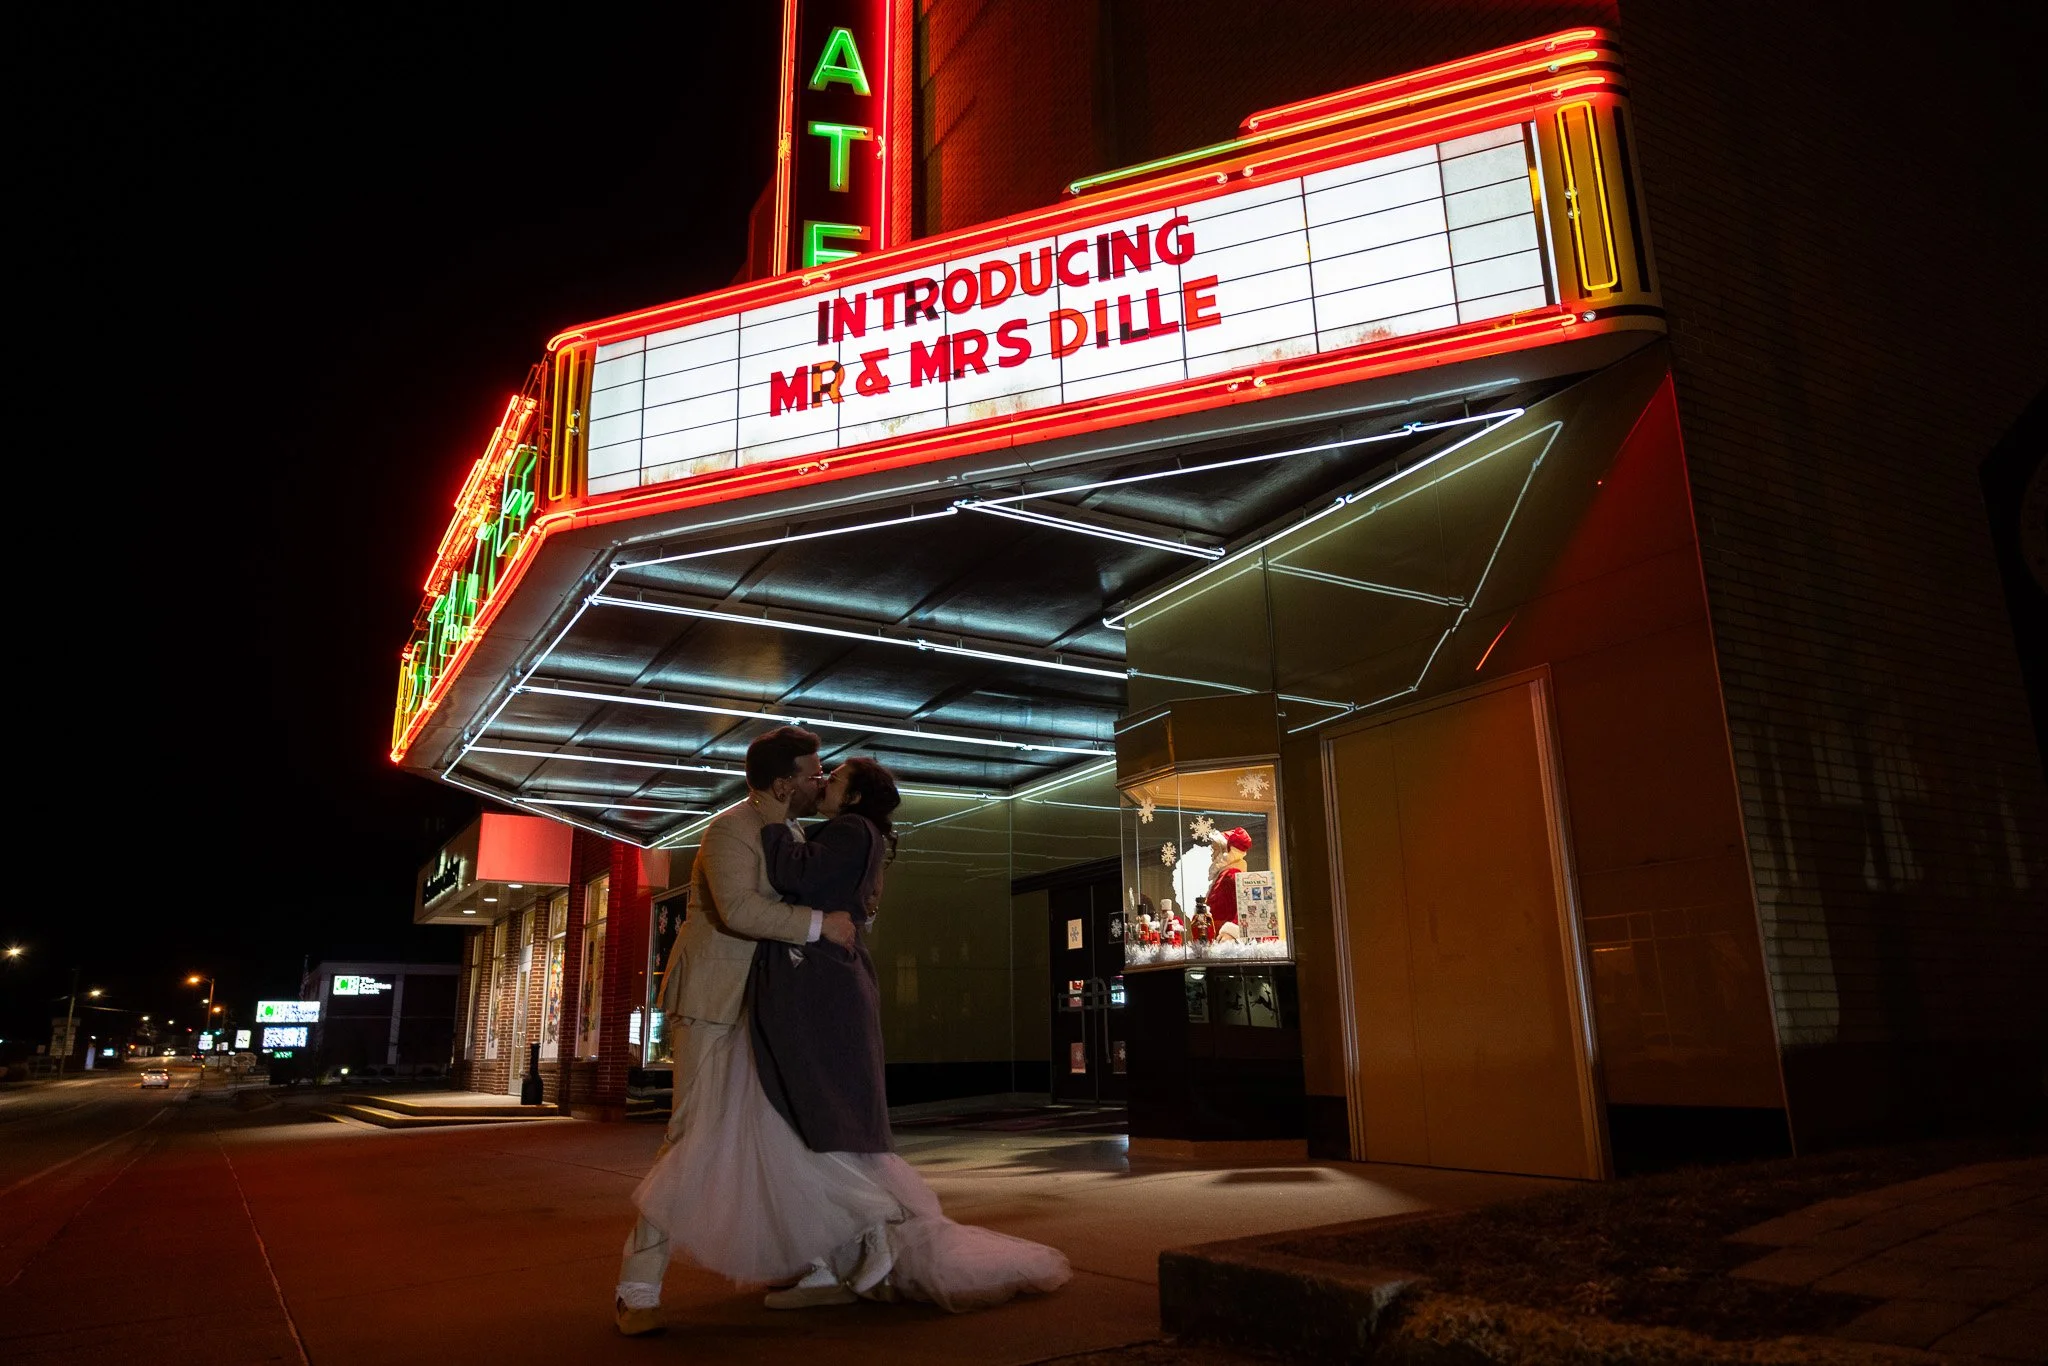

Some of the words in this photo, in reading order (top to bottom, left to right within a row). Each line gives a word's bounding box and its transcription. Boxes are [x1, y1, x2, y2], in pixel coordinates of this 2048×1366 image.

[769, 361, 846, 417] MR
[855, 347, 891, 397] &
[910, 318, 1033, 388] MRS
[1049, 274, 1223, 361] DILLE
[817, 216, 1196, 346] INTRODUCING
